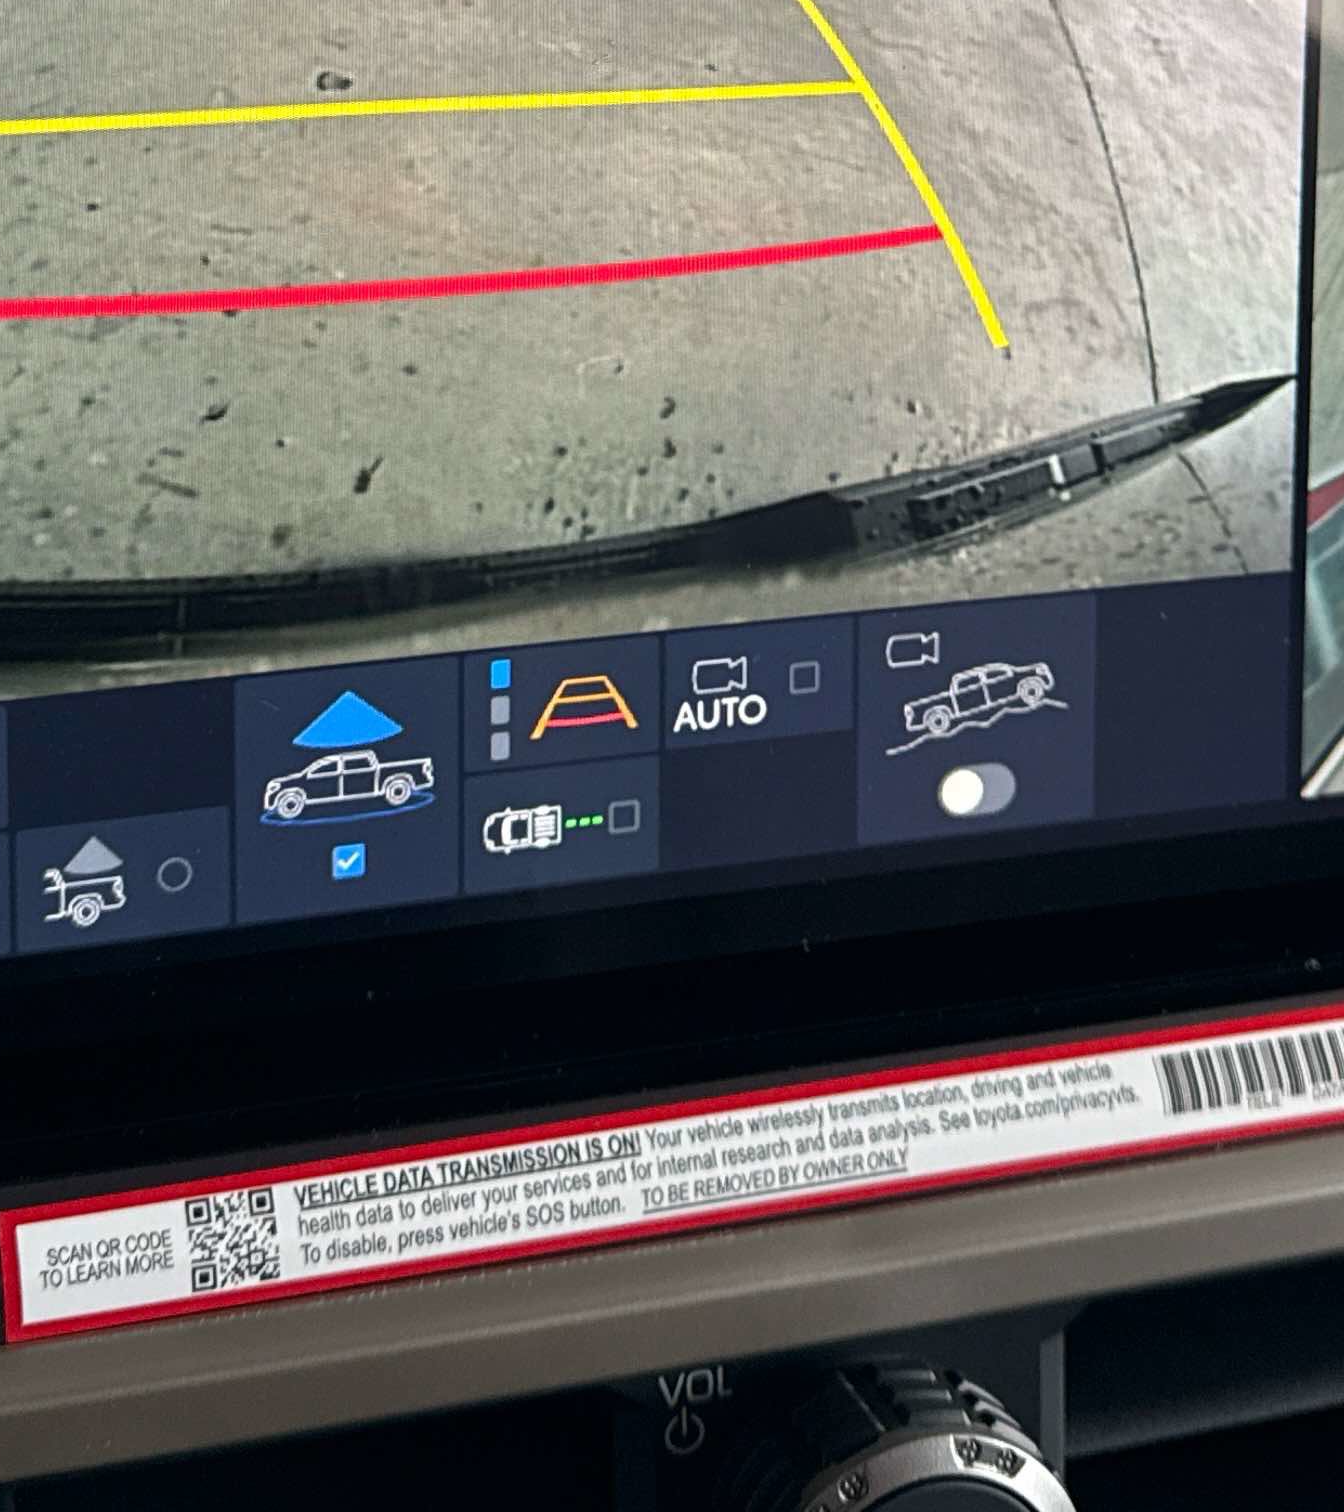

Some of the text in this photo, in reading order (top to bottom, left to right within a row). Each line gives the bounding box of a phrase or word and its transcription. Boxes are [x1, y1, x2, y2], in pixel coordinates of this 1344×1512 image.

[672, 694, 768, 733] AUTO
[293, 1059, 1113, 1207] VEHICLE DATA TRANSMISSION IS ON! Your vehicle wirelessly transmits location, driving and vehicle
[298, 1209, 352, 1237] health
[356, 1204, 394, 1229] data
[399, 1199, 416, 1220] to
[421, 1189, 477, 1216] deliver
[481, 1184, 518, 1213] your
[523, 1171, 592, 1200] services
[596, 1163, 627, 1187] and
[630, 1156, 653, 1180] for
[656, 1147, 718, 1178] internal
[721, 1136, 792, 1167] research
[795, 1130, 825, 1154] and
[829, 1125, 865, 1150] data
[868, 1117, 936, 1144] analysis.
[938, 1109, 971, 1133] See
[641, 1147, 909, 1208] TO BE REMOVED BY OWNER ONLY
[47, 1228, 173, 1267] SCAN QR CODE
[299, 1196, 626, 1266] To disable, press vehicle's SOS button.
[39, 1249, 175, 1289] TO LEARN MORE
[658, 1364, 733, 1409] VOL
